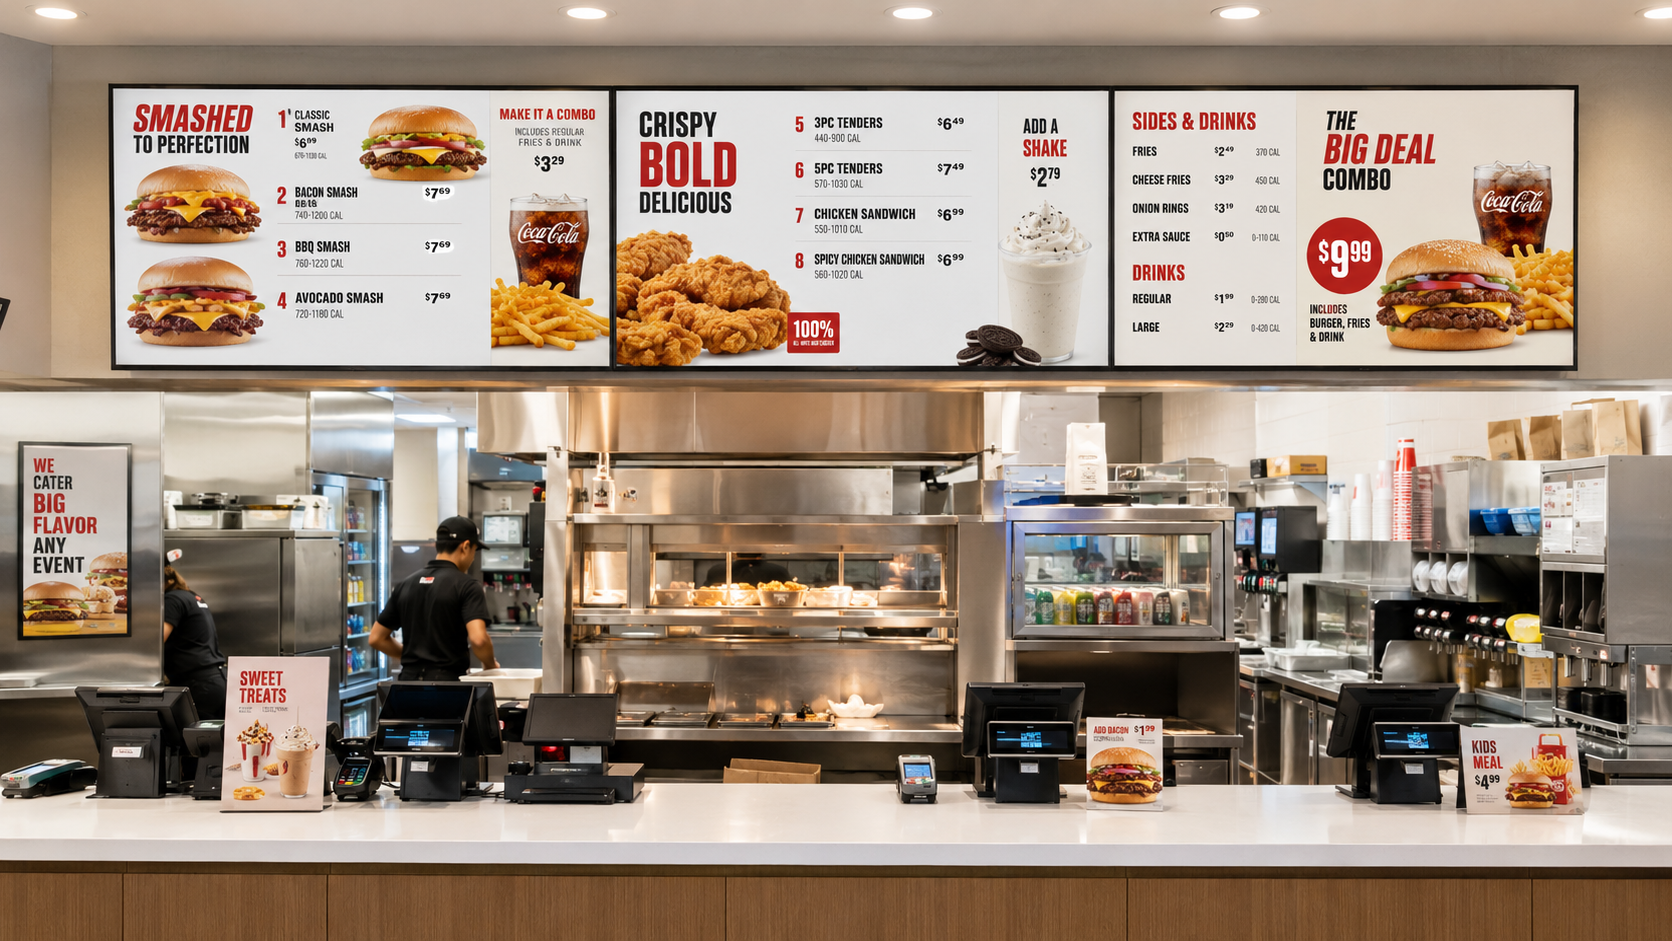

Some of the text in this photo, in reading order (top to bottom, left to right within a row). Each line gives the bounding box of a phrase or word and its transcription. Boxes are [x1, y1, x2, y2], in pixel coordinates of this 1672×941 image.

[133, 104, 253, 132] SMASHED
[278, 110, 286, 128] 1
[295, 110, 330, 120] CLASSIC
[500, 108, 595, 120] MAKE IT A COMBO
[295, 122, 334, 132] SMASH
[639, 111, 717, 138] CRISPY
[795, 116, 804, 133] 5
[814, 117, 883, 128] 3PC TENDERS
[937, 117, 964, 130] $649
[1023, 118, 1058, 134] ADD A
[1133, 112, 1256, 130] SIDES & DRINKS
[1327, 111, 1358, 131] THE
[515, 127, 584, 136] INCLUDES REGULAR
[519, 138, 582, 147] FRIES & DRINK
[814, 133, 861, 143] 440-900 CAL
[133, 135, 249, 154] TO PERFECTION
[1023, 139, 1067, 157] SHAKE
[1324, 133, 1436, 165] BIG DEAL
[1133, 146, 1157, 156] FRIES
[1214, 146, 1234, 156] $249
[1256, 148, 1280, 156] 370 CAL
[534, 155, 564, 172] $329
[640, 141, 737, 187] BOLD
[814, 163, 883, 174] 5PC TENDERS
[937, 163, 964, 175] $749
[795, 162, 804, 178] 6
[1030, 167, 1060, 187] $279
[1132, 174, 1191, 185] CHEESE FRIES
[1214, 174, 1234, 185] $329
[1255, 176, 1280, 185] 450 CAL
[1323, 168, 1391, 190] COMBO
[814, 179, 863, 188] 570-1030 CAL
[277, 186, 286, 204] 2
[295, 187, 358, 198] BACON SMASH
[425, 187, 450, 199] $769
[640, 191, 732, 214] DELICIOUS
[1132, 203, 1189, 213] ONION RINGS
[1214, 203, 1234, 213] $319
[295, 210, 343, 220] 740-1200 CAL
[795, 207, 804, 223] 7
[814, 208, 915, 220] CHICKEN SANDWICH
[937, 208, 964, 221] $699
[1255, 205, 1280, 213] 420 CAL
[814, 224, 863, 234] 550-1010 CAL
[1133, 231, 1190, 242] EXTRA SAUCE
[1252, 233, 1280, 242] 0-110 CAL
[277, 240, 286, 258] 3
[295, 241, 350, 254] BBQ SMASH
[425, 241, 451, 253] $769
[295, 258, 344, 268] 760-1220 CAL
[795, 252, 804, 269] 8
[814, 253, 925, 265] SPICY CHICKEN SANDWICH
[937, 253, 964, 266] $699
[1318, 239, 1372, 278] $999
[814, 270, 863, 279] 560-1020 CAL
[1133, 264, 1185, 281] DRINKS
[277, 292, 287, 309] 4
[295, 292, 383, 303] AVOCADO SMASH
[425, 292, 451, 304] $769
[1133, 293, 1171, 304] REGULAR
[1214, 293, 1234, 304] $199
[296, 309, 344, 319] 720-1180 CAL
[1310, 304, 1347, 314] INCLUDES
[793, 320, 834, 338] 100%
[1133, 322, 1160, 332] LARGE
[1214, 322, 1234, 332] $229
[1251, 324, 1280, 332] 0-420 CAL
[1310, 318, 1370, 329] BURGER, FRIES
[1310, 331, 1344, 342] & DRINK
[33, 458, 54, 473] WE
[34, 475, 72, 490] CATER
[34, 493, 65, 513] BIG
[33, 516, 97, 534] FLAVOR
[33, 537, 66, 554] ANY
[33, 556, 85, 574] EVENT
[240, 671, 283, 686] SWEET
[239, 688, 286, 703] TREATS
[1134, 725, 1155, 736] $199
[1472, 740, 1497, 754] KIDS
[1473, 755, 1503, 769] MEAL
[1475, 774, 1500, 790] $499
